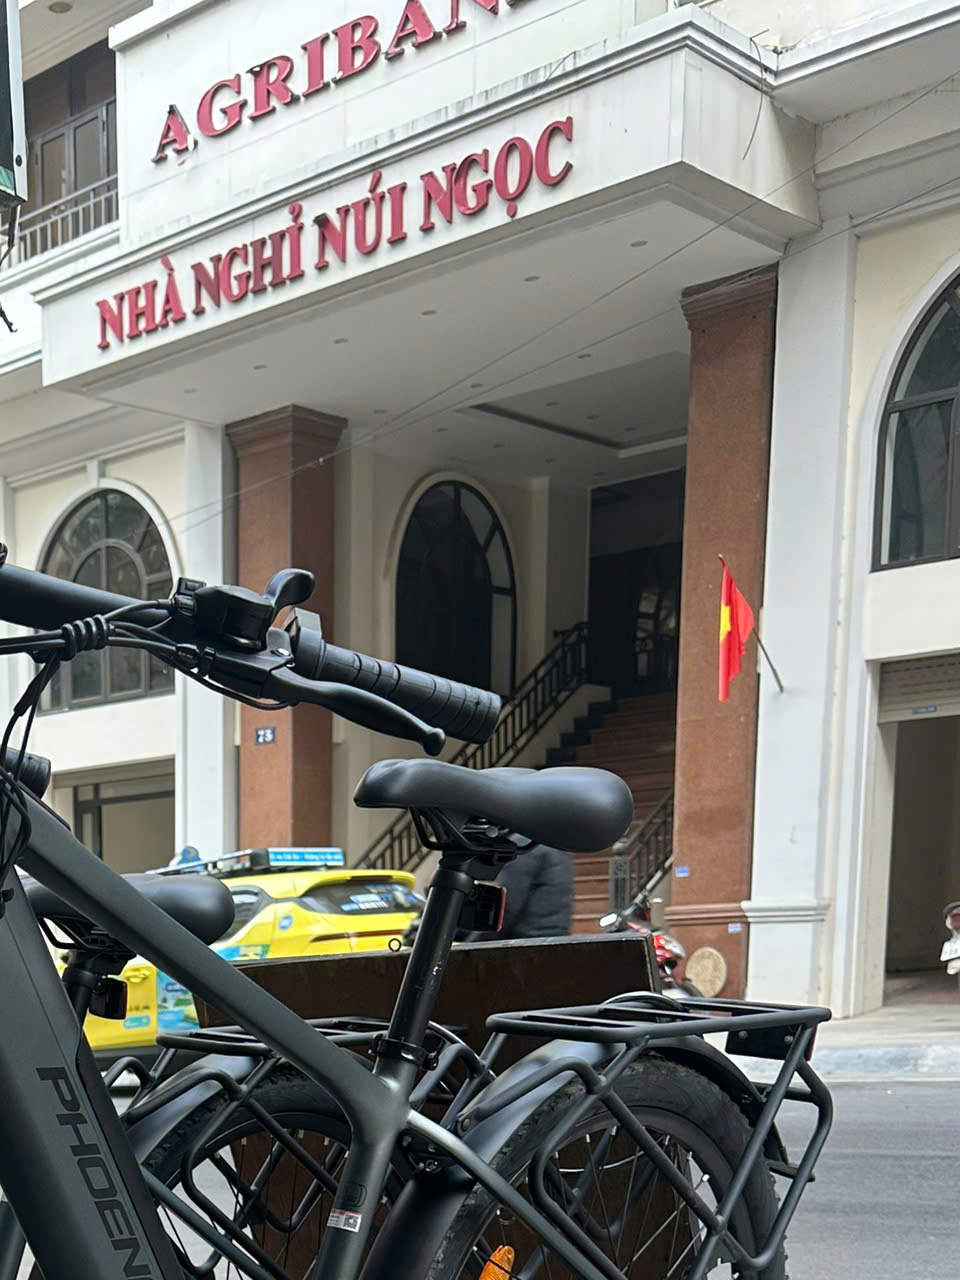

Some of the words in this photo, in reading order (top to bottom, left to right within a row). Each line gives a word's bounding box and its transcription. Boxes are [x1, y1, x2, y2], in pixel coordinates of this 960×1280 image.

[152, 0, 532, 163] AGRIBA
[96, 255, 186, 350] NHÀ
[191, 201, 305, 316] NGHỈ
[313, 170, 408, 271] NÚI
[419, 115, 575, 232] NGỌC
